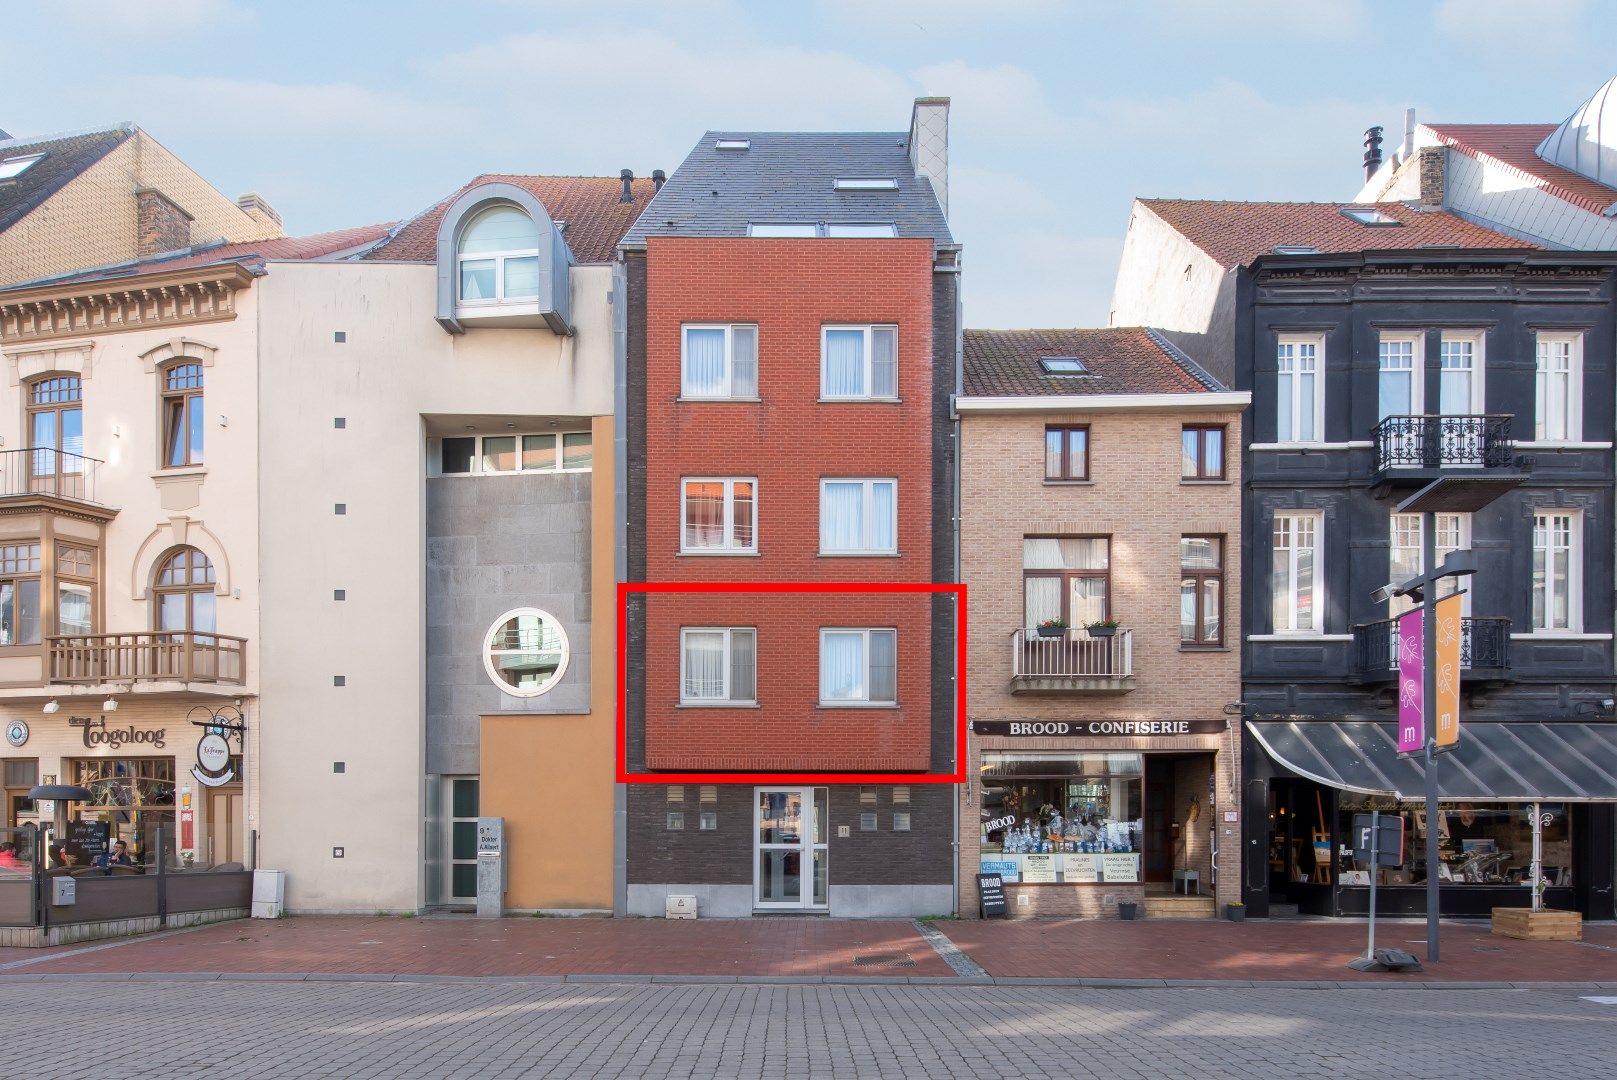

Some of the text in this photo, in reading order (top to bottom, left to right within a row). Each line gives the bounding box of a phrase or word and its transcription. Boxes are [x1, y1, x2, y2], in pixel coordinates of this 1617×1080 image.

[83, 717, 166, 750] Toogoloog
[1009, 722, 1069, 735] BROOD
[1088, 721, 1189, 734] CONFISERIE
[1404, 726, 1416, 743] m
[479, 827, 485, 835] 9
[985, 814, 1016, 834] BROOD
[61, 889, 65, 897] 7
